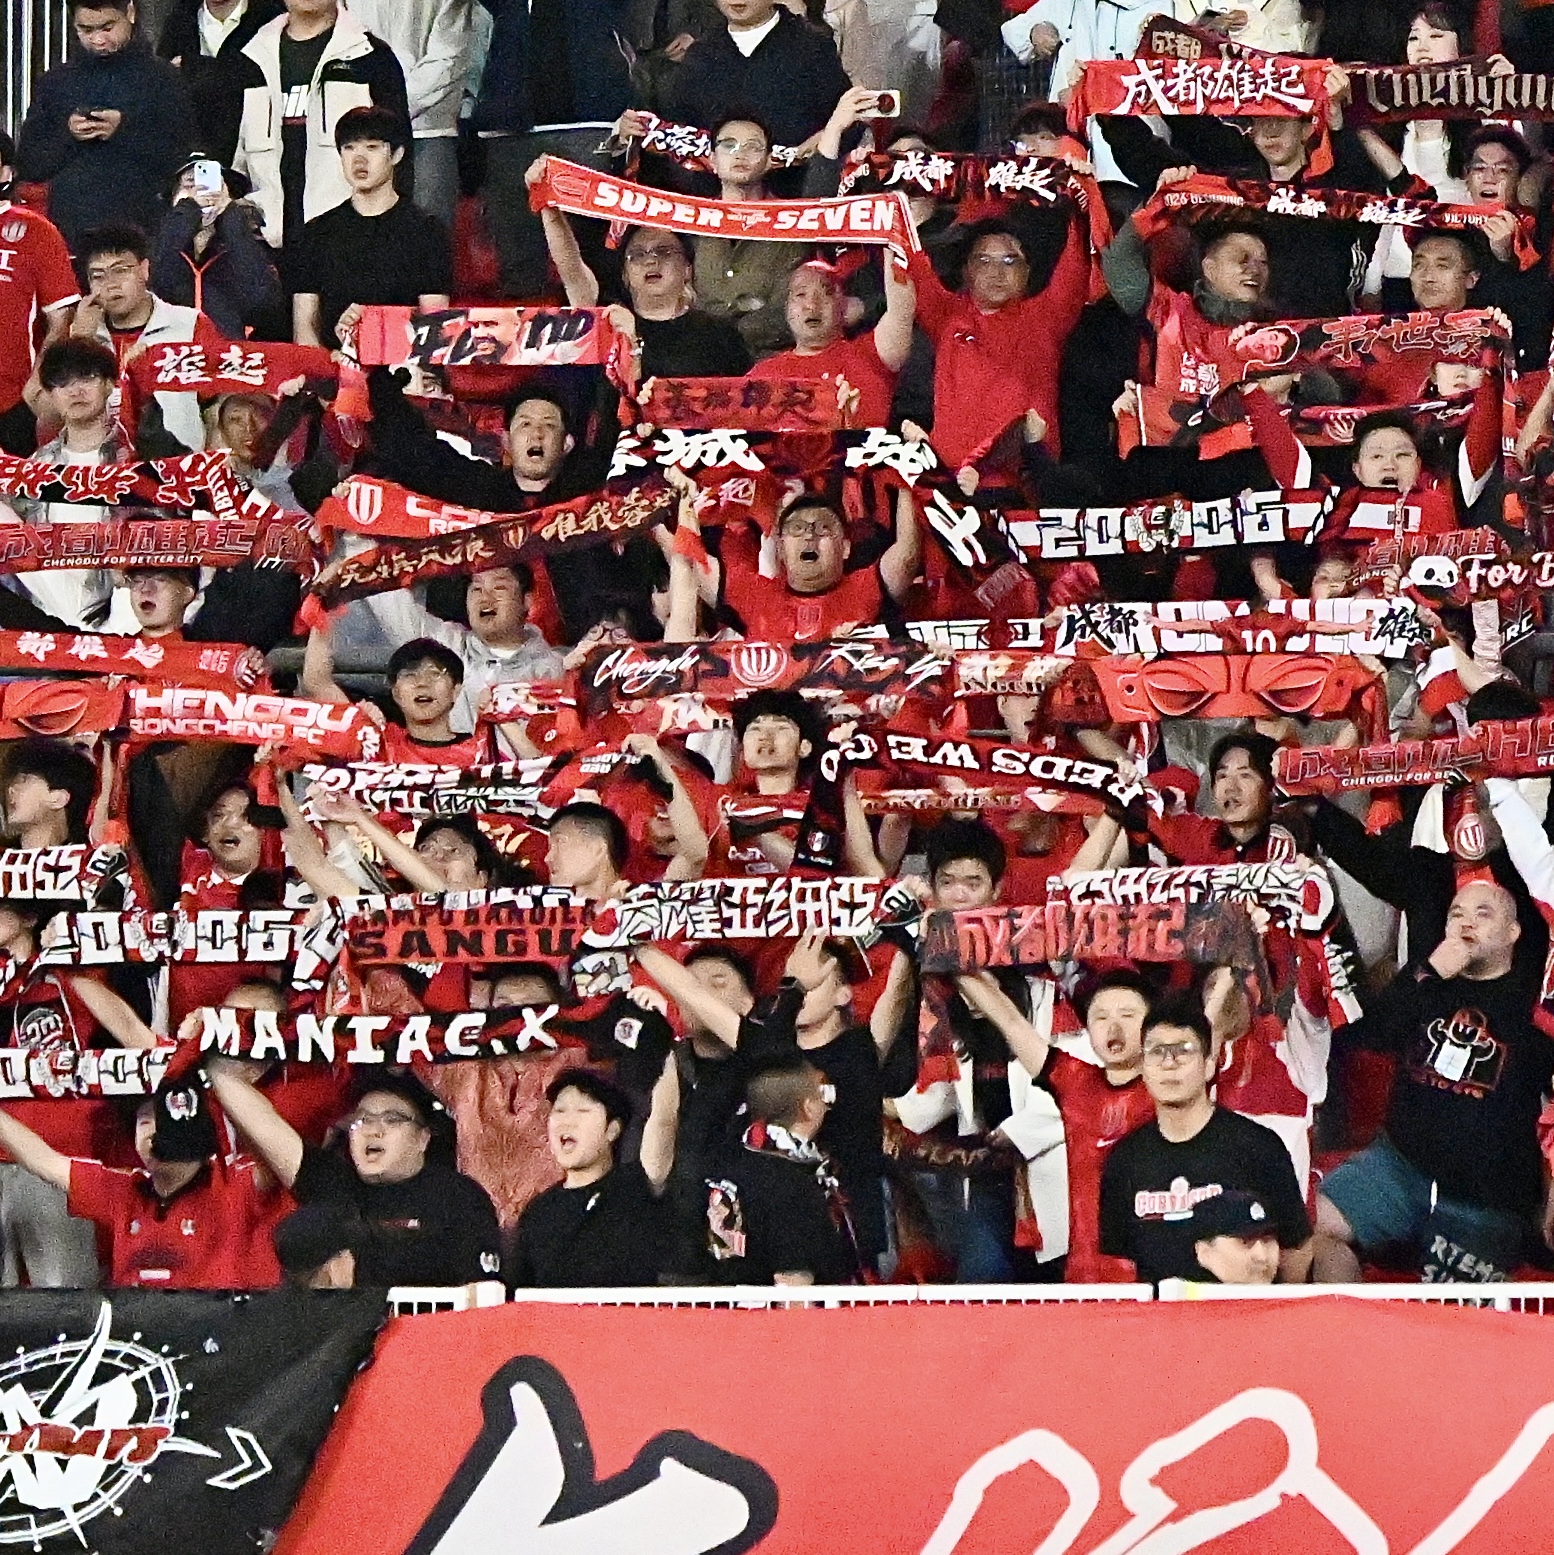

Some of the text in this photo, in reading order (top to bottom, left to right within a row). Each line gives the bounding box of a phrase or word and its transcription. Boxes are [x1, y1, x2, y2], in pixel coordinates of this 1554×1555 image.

[1120, 57, 1315, 115] 成都雄起
[887, 151, 955, 190] 成都
[985, 158, 1058, 201] 雄起
[593, 180, 896, 233] SUPER SEVEN
[1464, 555, 1525, 590] For
[594, 641, 700, 695] Chengdu
